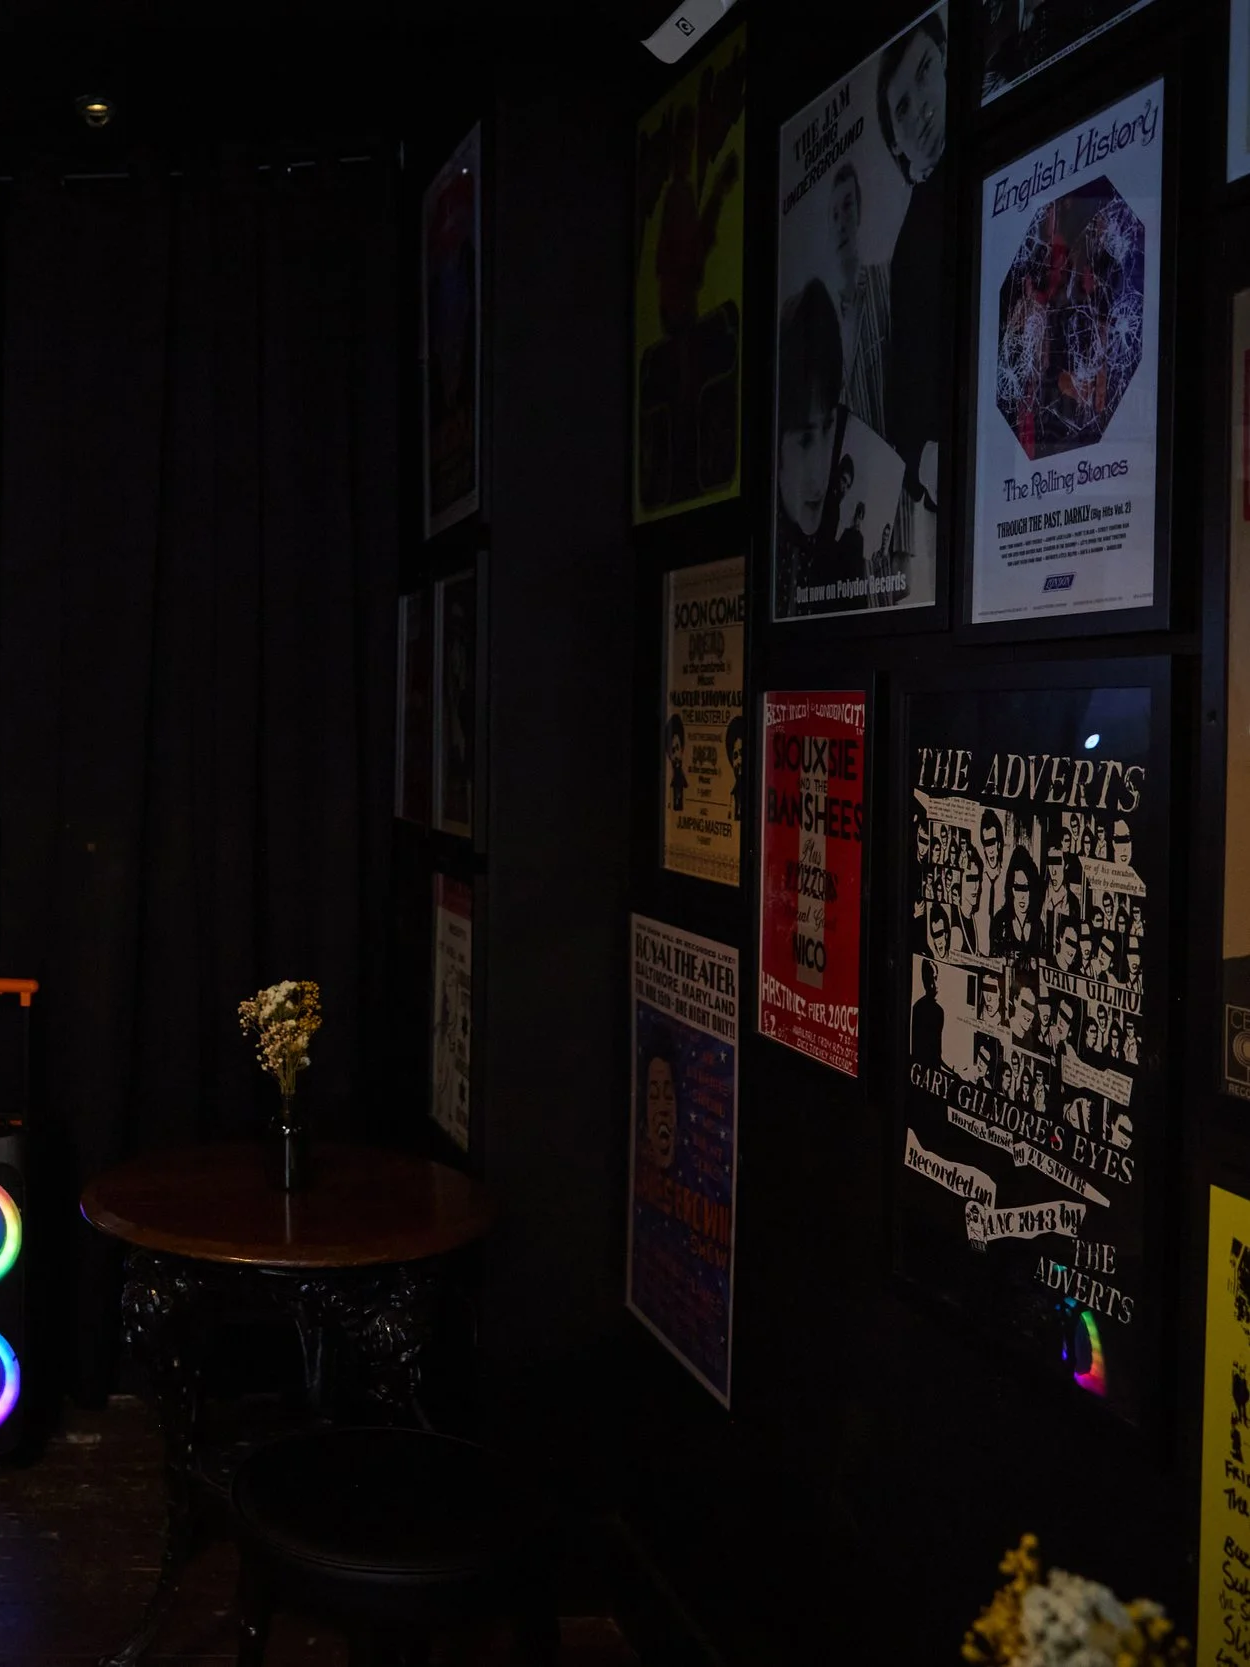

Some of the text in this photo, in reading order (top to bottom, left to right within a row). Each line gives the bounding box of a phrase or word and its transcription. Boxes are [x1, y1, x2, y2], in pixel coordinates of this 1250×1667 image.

[794, 83, 849, 161] THE JAM
[783, 116, 864, 216] UNDERGROUND
[805, 122, 838, 171] GOING
[992, 98, 1159, 217] English History
[1003, 459, 1129, 501] The Rolling Stones
[997, 517, 1028, 539] THROUGH
[1028, 514, 1043, 533] THE
[1064, 504, 1091, 527] DARKLY
[796, 572, 906, 603] Out now on Polydor Records
[674, 601, 707, 629] SOON
[773, 733, 859, 780] SIOUXSIE
[814, 778, 829, 794] THE
[918, 748, 973, 792] THE
[981, 752, 1146, 813] ADVERTS
[767, 788, 864, 842] BANSHEES
[636, 932, 736, 998] ROYAL THEATER
[793, 932, 827, 973] NICO
[683, 982, 735, 1018] MARYLAND
[688, 1003, 710, 1029] NIGHT
[808, 1002, 827, 1026] PIER
[910, 1062, 1135, 1185] GARY GILMORE'S EYES
[979, 1127, 987, 1140] &
[908, 1146, 993, 1207] Recorded on
[986, 1203, 1082, 1236] ANC 1043 by
[1072, 1238, 1117, 1276] THE
[1034, 1255, 1135, 1325] ADVERTS
